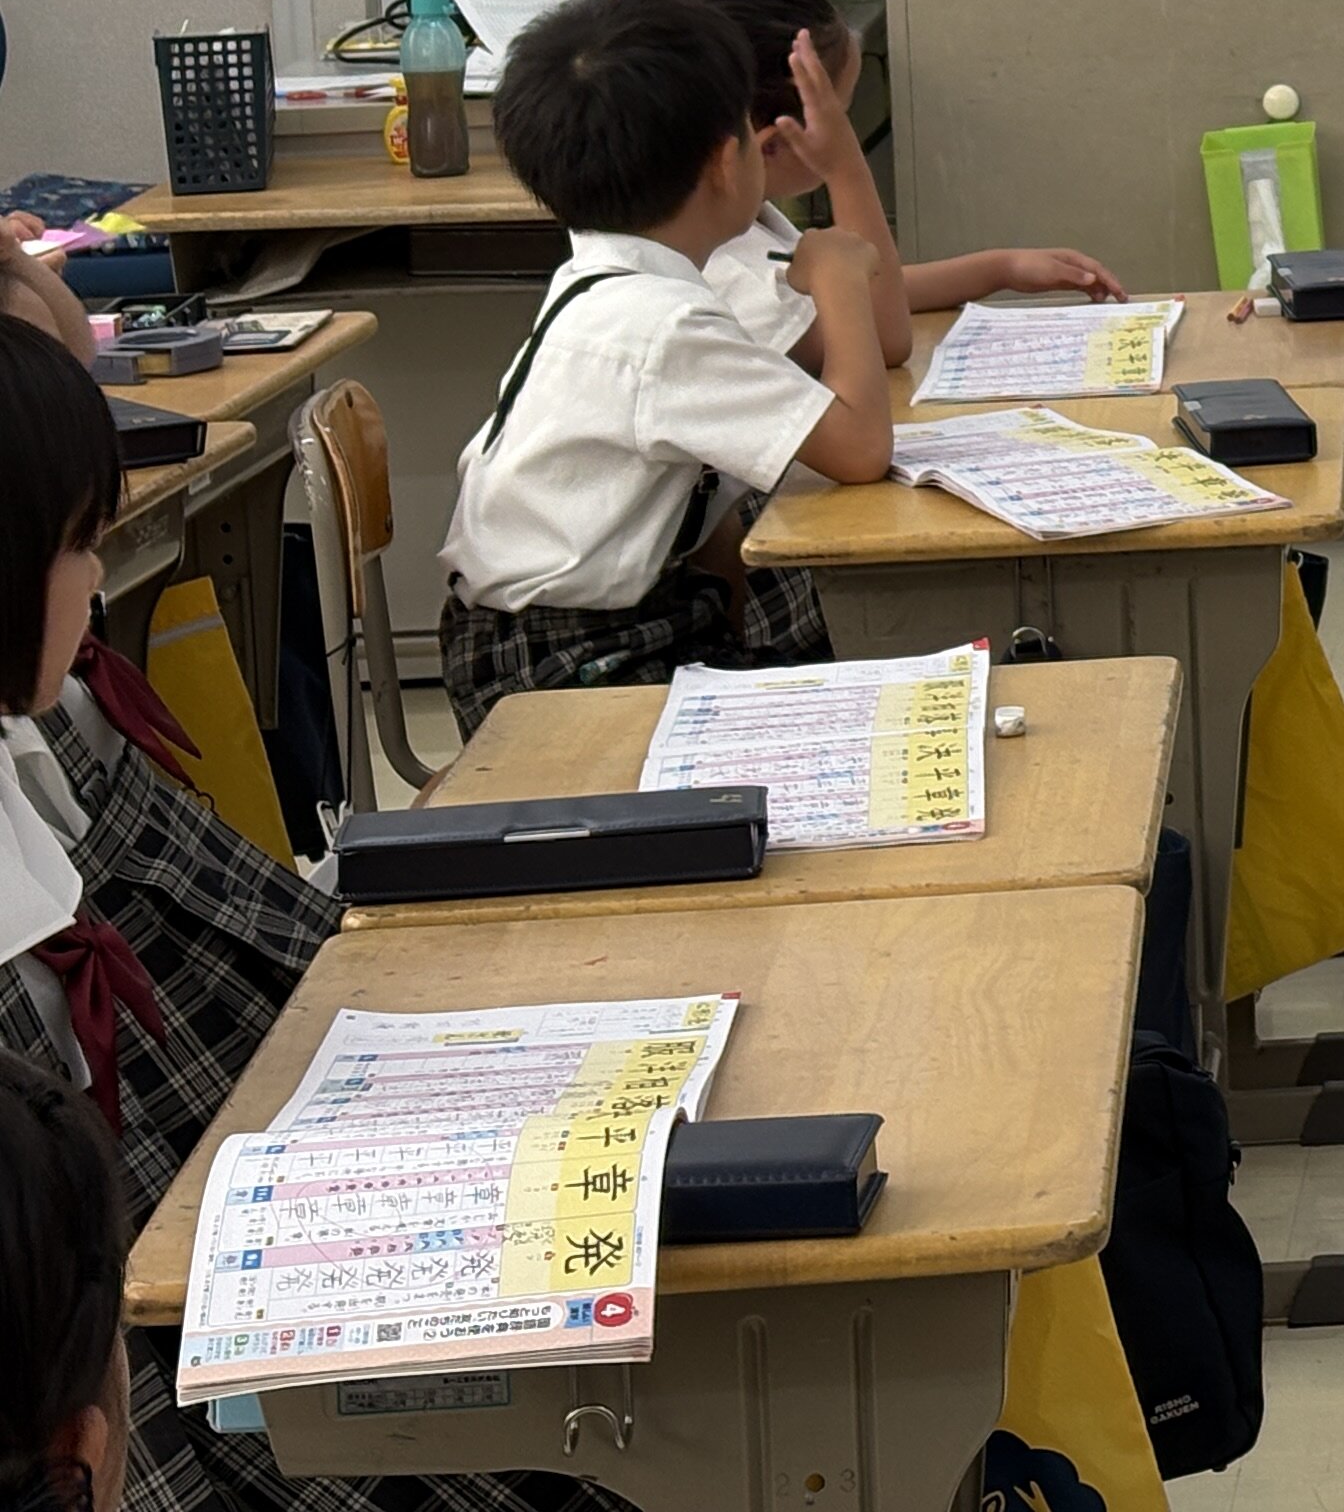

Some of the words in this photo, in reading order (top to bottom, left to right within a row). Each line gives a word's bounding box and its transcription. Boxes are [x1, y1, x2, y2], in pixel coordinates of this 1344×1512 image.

[576, 1124, 639, 1150] 平
[581, 1163, 634, 1204] 章
[460, 1248, 497, 1279] 発
[563, 1227, 628, 1278] 発
[599, 1303, 626, 1318] 4
